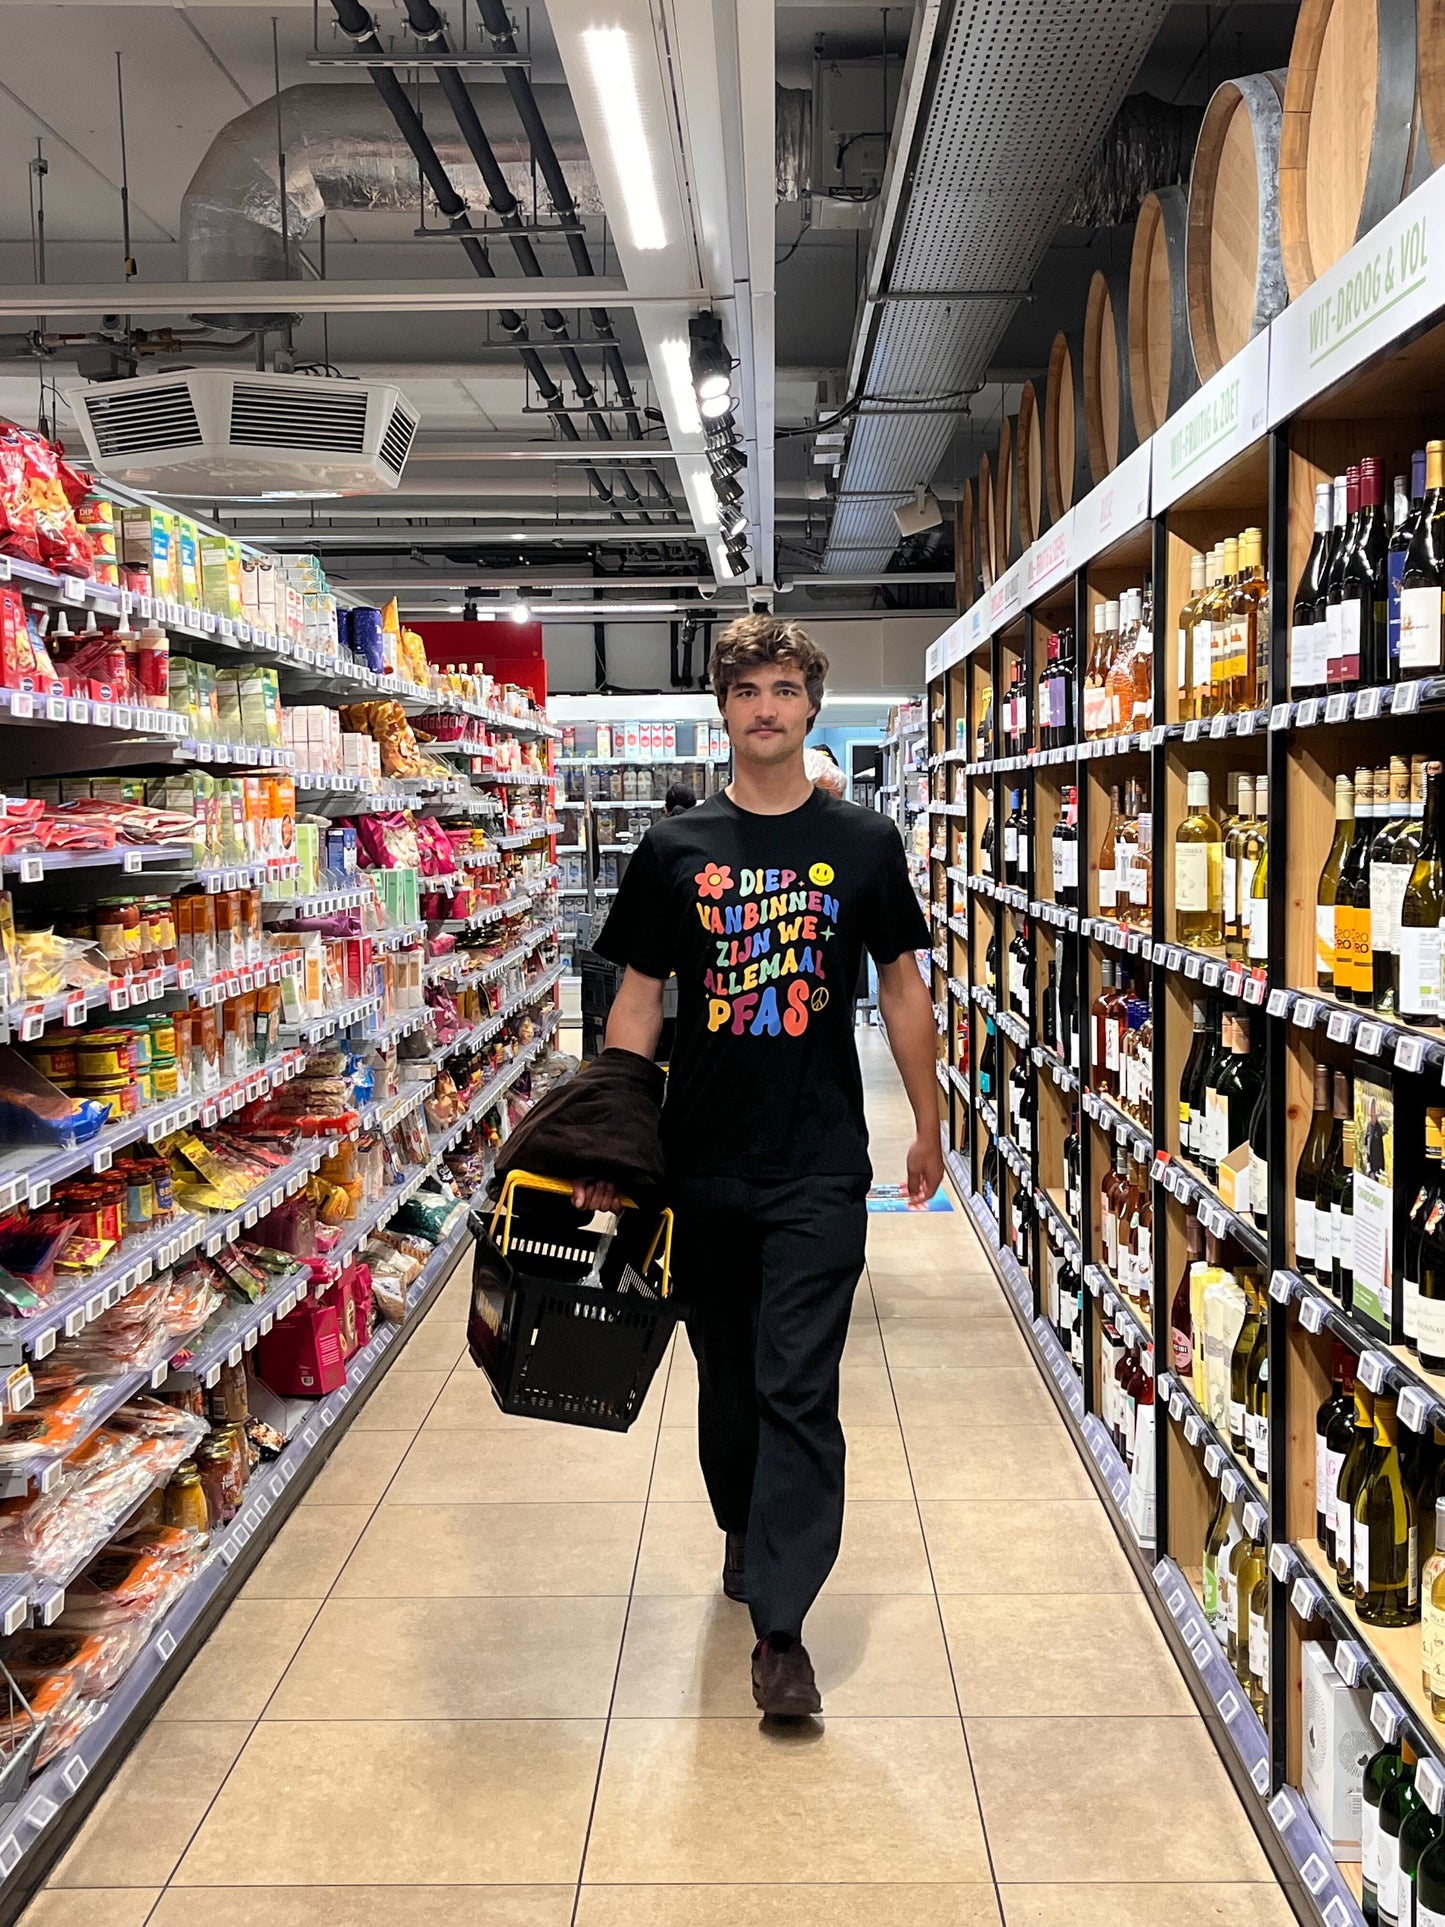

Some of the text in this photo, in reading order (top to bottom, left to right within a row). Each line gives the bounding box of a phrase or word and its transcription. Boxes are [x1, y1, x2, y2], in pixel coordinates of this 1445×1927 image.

[1309, 216, 1428, 353] WIT-DROOG & VOL
[79, 508, 94, 516] DIP
[739, 868, 797, 897] DIEP
[696, 890, 840, 935] VANBINNEN
[716, 915, 818, 967] ZIJN WE
[703, 946, 826, 995] ALLEMAAL
[707, 979, 809, 1036] PFAS
